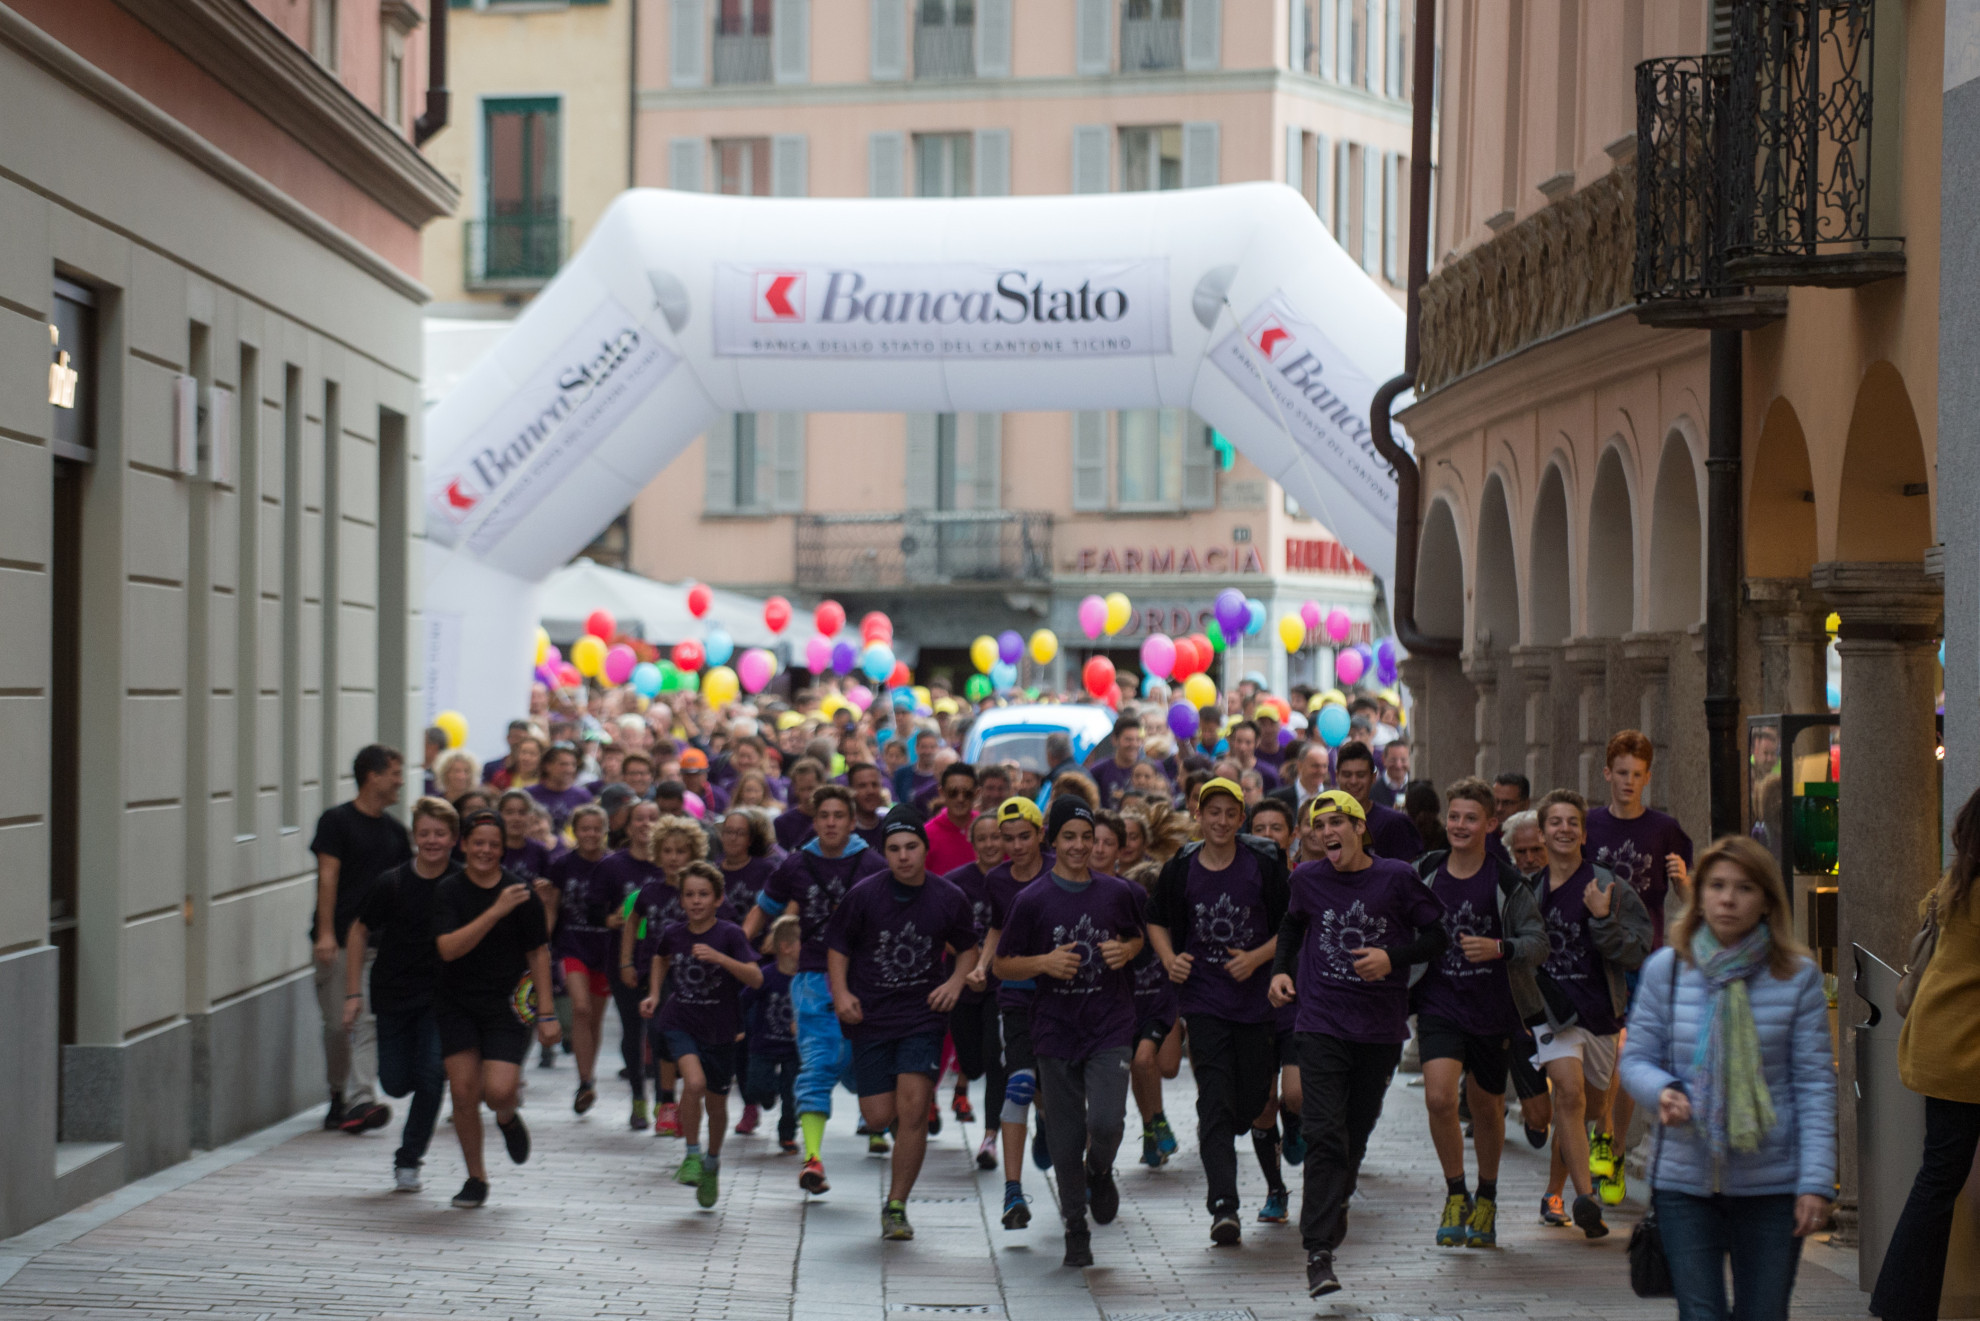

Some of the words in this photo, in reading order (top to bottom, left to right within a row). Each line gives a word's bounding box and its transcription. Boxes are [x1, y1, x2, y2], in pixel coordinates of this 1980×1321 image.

[818, 270, 1129, 324] BancaStato
[753, 339, 810, 351] BANCA
[820, 338, 873, 352] DELLO
[880, 338, 934, 352] STATO
[944, 338, 971, 352] DEL
[984, 338, 1063, 352] CANTONE
[1072, 337, 1131, 351] TICINO
[1078, 545, 1264, 574] FARMACIA
